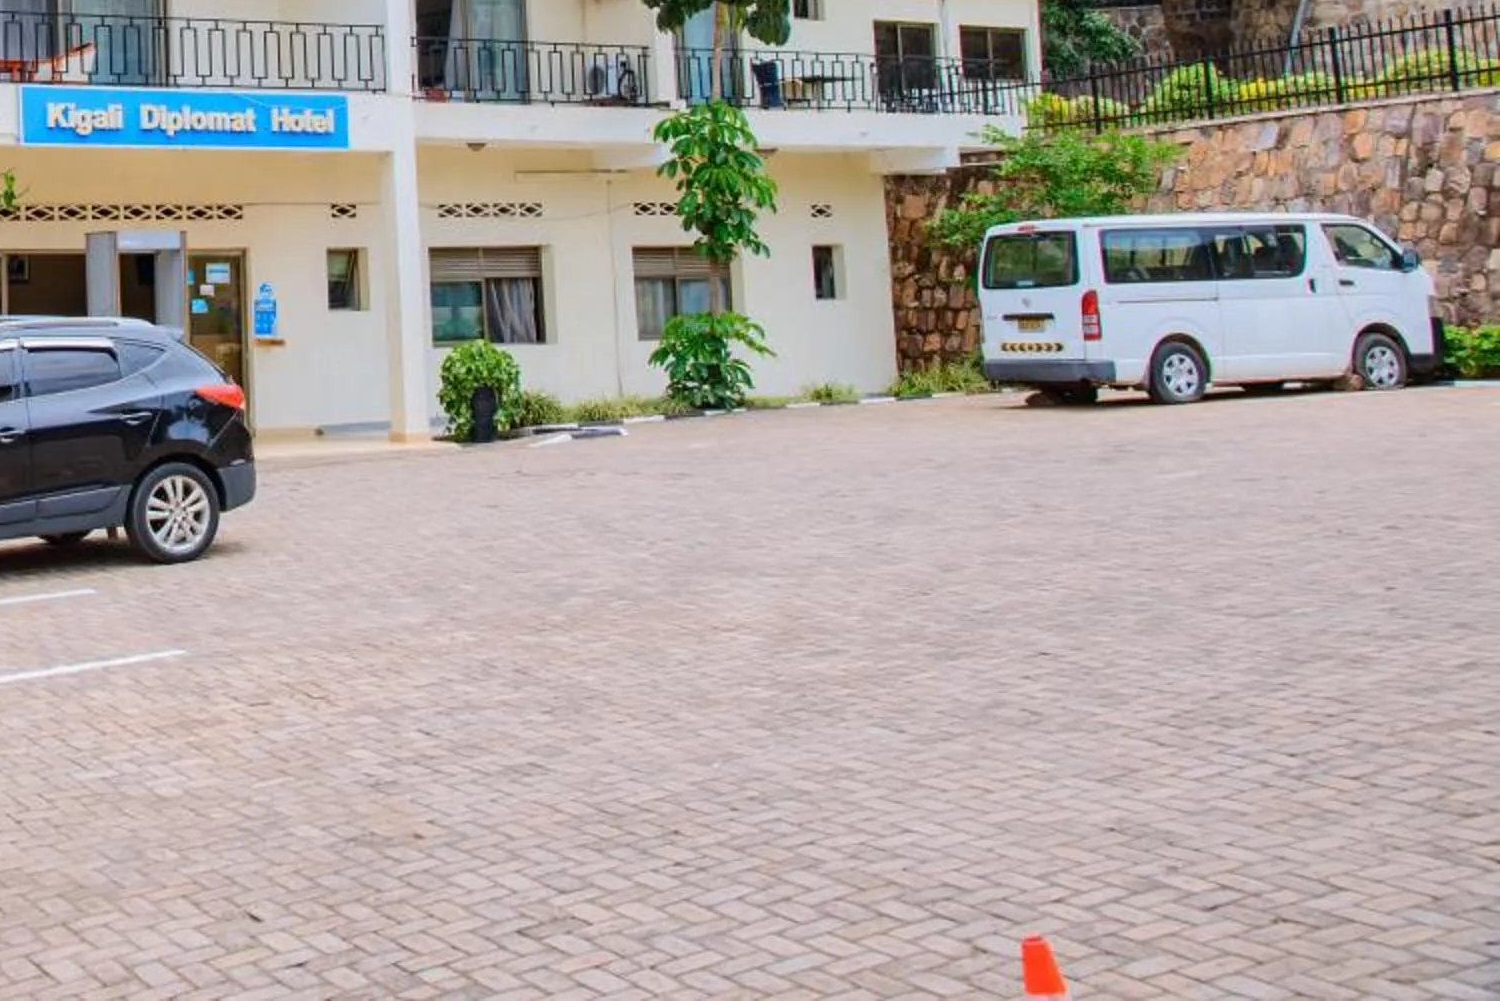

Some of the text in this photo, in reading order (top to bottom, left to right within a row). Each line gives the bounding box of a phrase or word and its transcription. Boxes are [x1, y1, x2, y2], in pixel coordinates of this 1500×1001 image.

[46, 102, 336, 136] Kigali Diplomat Hotel
